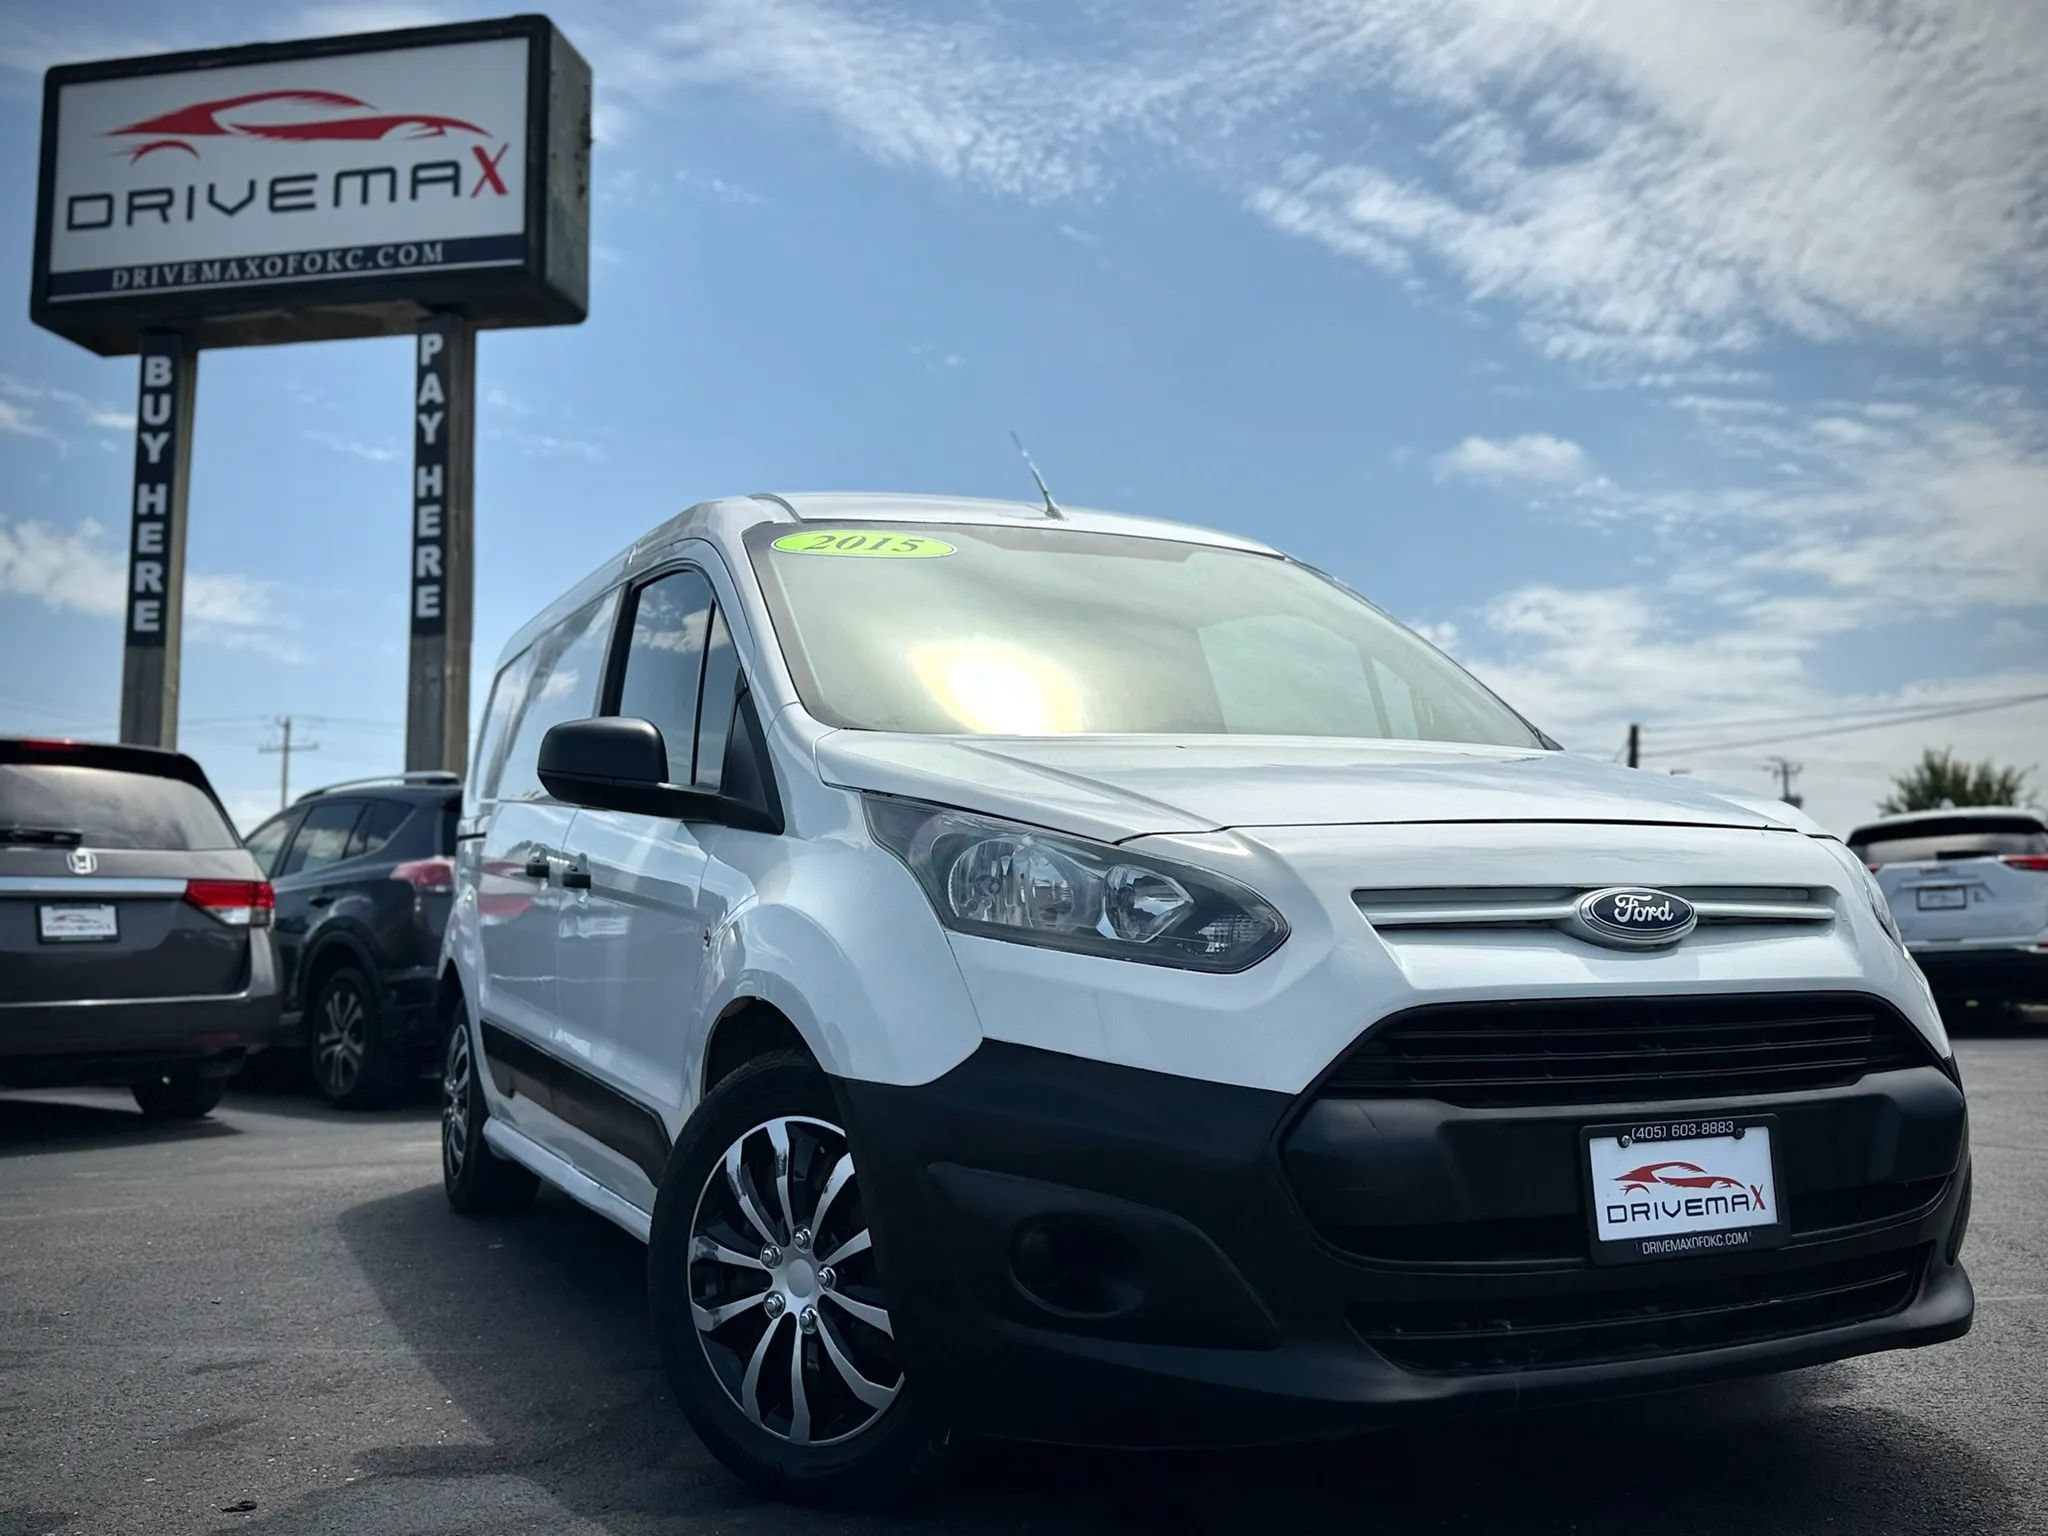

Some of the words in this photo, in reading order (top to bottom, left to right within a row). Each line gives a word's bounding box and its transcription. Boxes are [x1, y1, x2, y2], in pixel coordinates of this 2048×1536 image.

[66, 143, 509, 231] DRIVEMAX
[111, 242, 445, 290] DRIVEMAXOFOKC.COM
[141, 355, 173, 464] BUY
[417, 333, 445, 444] PAY
[133, 483, 168, 632] HERE
[415, 464, 443, 619] HERE
[802, 535, 925, 552] 2015
[1613, 894, 1674, 923] Ford
[1631, 1126, 1667, 1140] (405)
[1671, 1121, 1734, 1137] 603-8883
[1606, 1184, 1766, 1224] DRIVEMAX
[1642, 1231, 1748, 1255] DRIVEMAXOFOKC.COM
